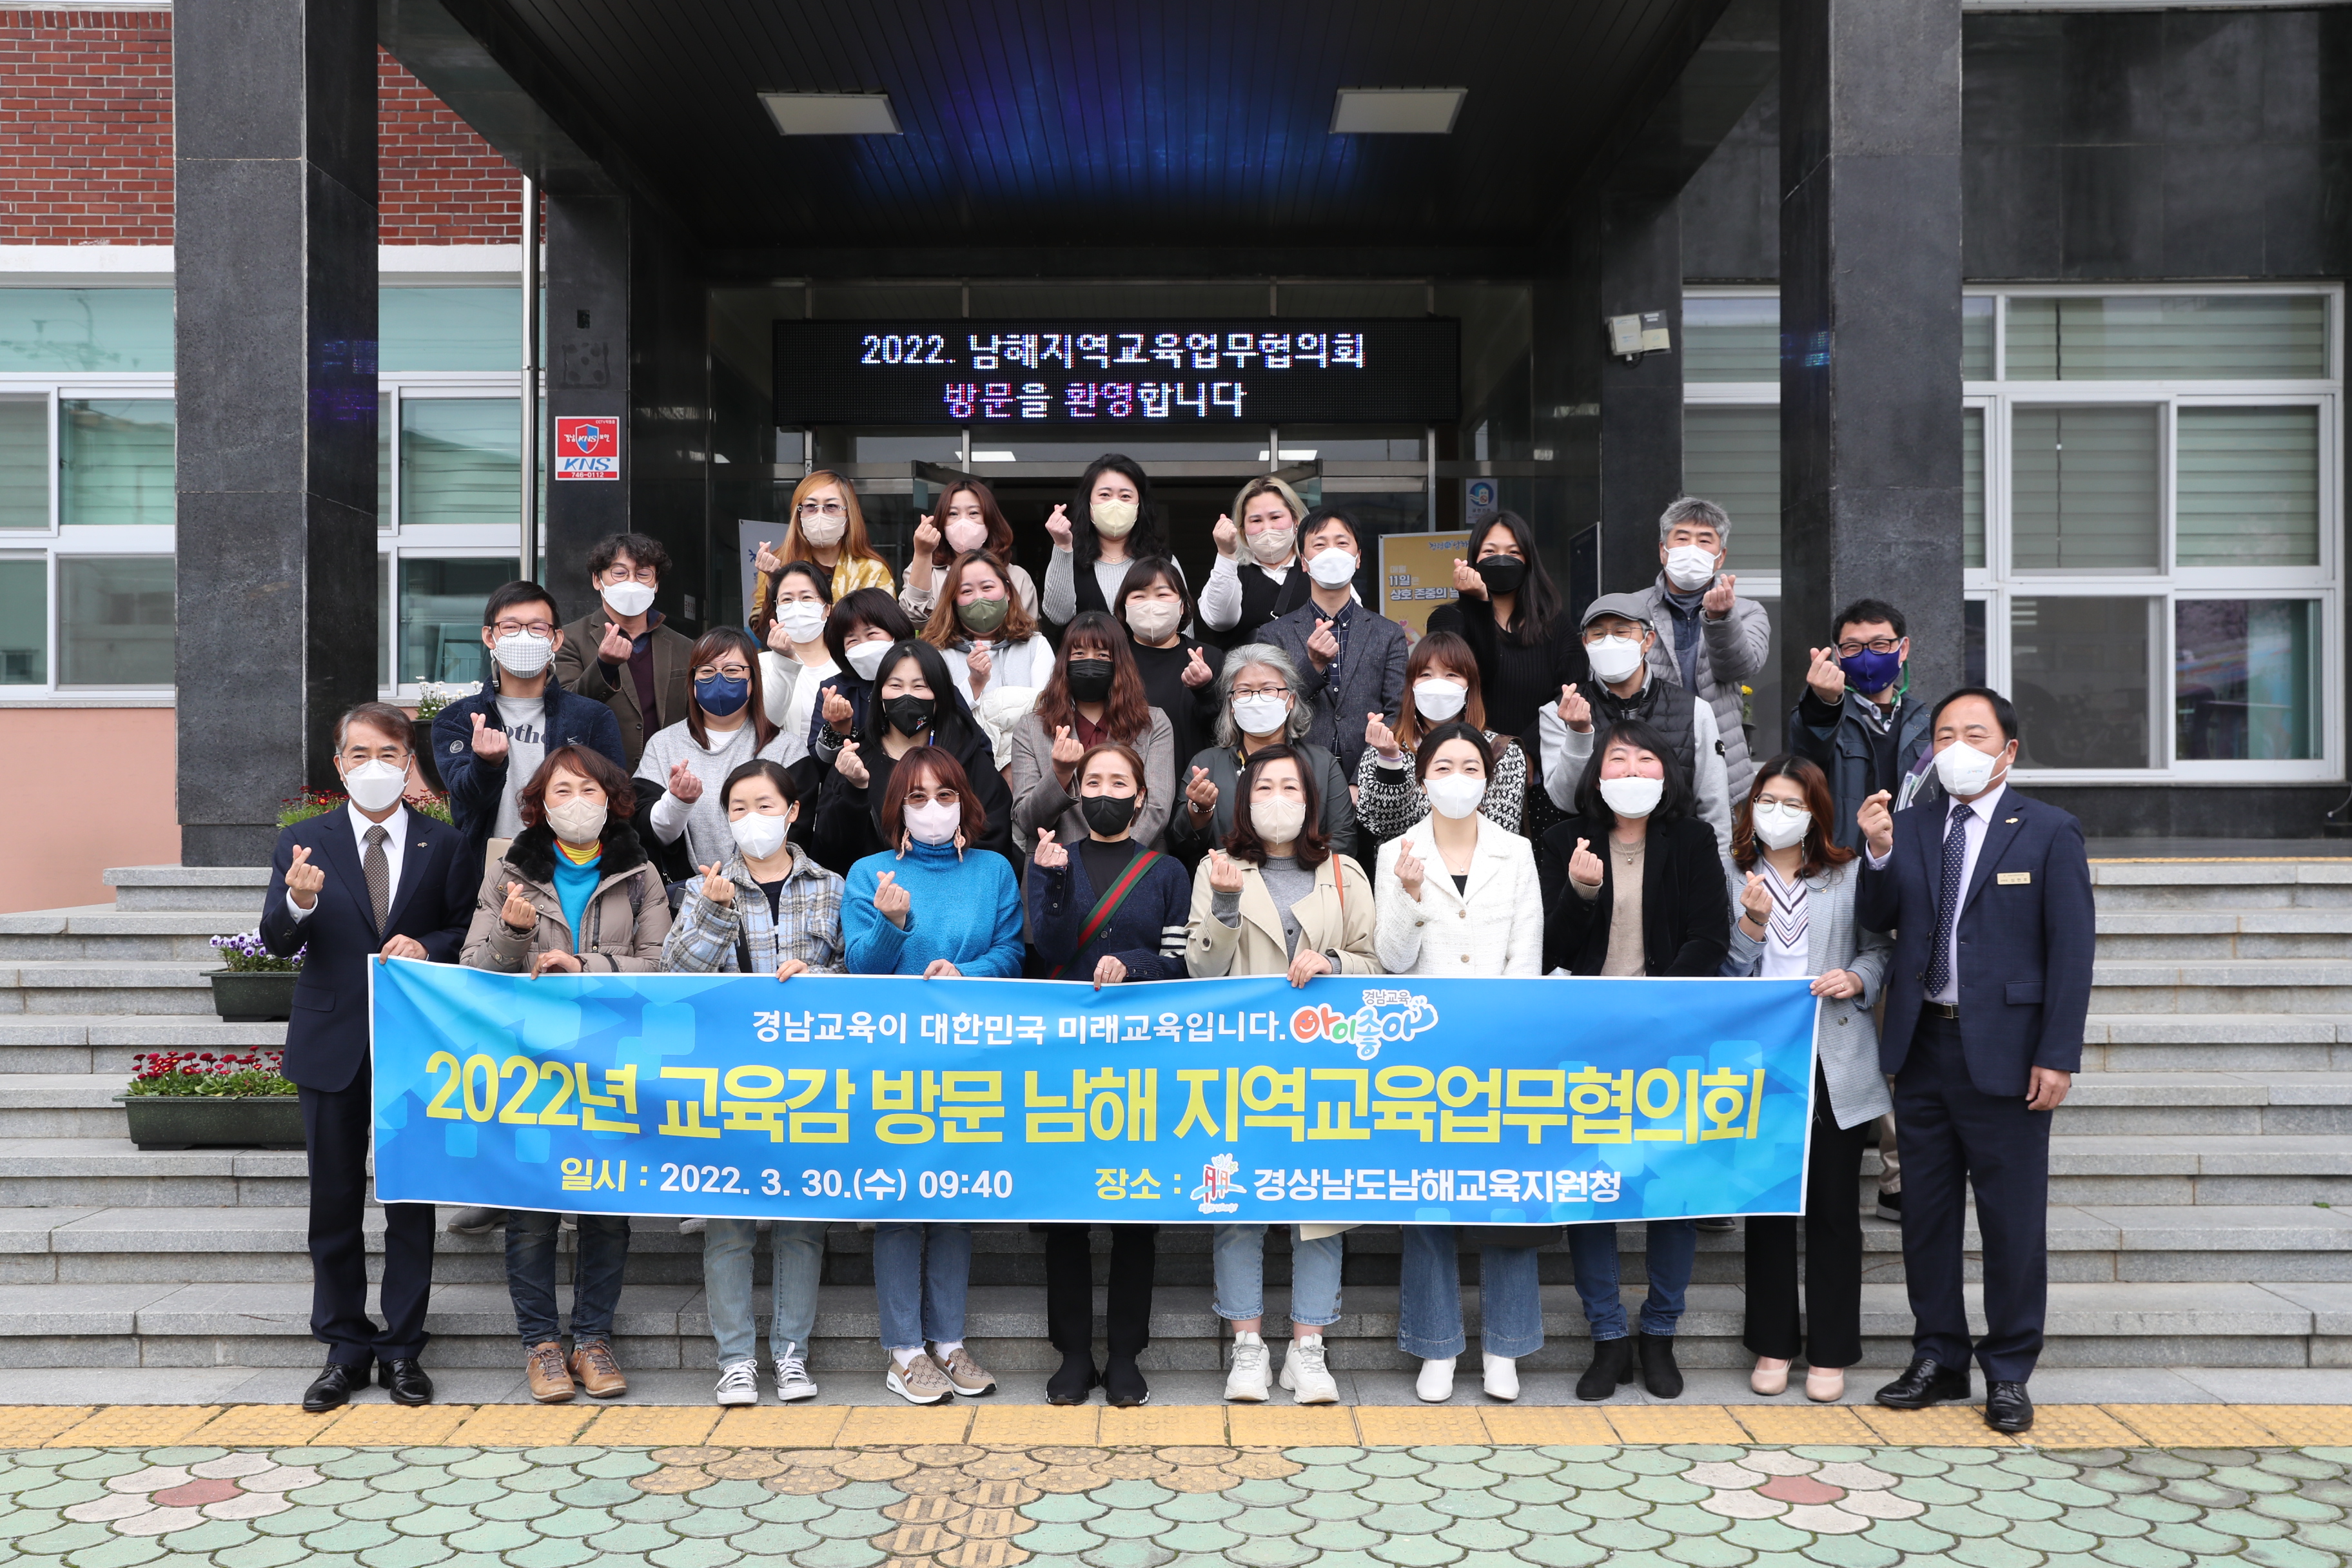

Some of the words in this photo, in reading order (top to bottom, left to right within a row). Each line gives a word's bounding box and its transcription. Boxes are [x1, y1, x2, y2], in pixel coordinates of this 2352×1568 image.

[861, 335, 956, 364] 2022.
[968, 333, 1365, 369] 남해지역교육업무협의회
[943, 382, 1053, 418] 방문을
[1064, 382, 1248, 418] 환영합니다
[564, 433, 576, 442] 경남
[600, 434, 610, 442] 보안
[564, 457, 611, 471] KNS
[1391, 589, 1412, 600] 상호
[1414, 587, 1447, 600] 존중의
[1364, 991, 1410, 1004] 경남교육
[753, 1010, 906, 1043] 경남교육이
[921, 1012, 1044, 1044] 대한민국
[1059, 1010, 1285, 1044] 미래교육입니다.
[1293, 1003, 1438, 1057] 아이좋아
[426, 1051, 640, 1133] 2022년
[659, 1065, 856, 1143] 교육감
[872, 1070, 1004, 1144] 방문
[1025, 1067, 1157, 1142] 남해
[1173, 1065, 1765, 1144] 지역교육업무협의회
[561, 1158, 625, 1191] 일시
[660, 1162, 750, 1195] 2022.
[761, 1168, 790, 1196] 3.
[801, 1168, 907, 1201] 30.(수)
[919, 1170, 1013, 1199] 09:40
[1095, 1169, 1161, 1200] 장소
[1253, 1169, 1621, 1202] 경상남도남해교육지원청
